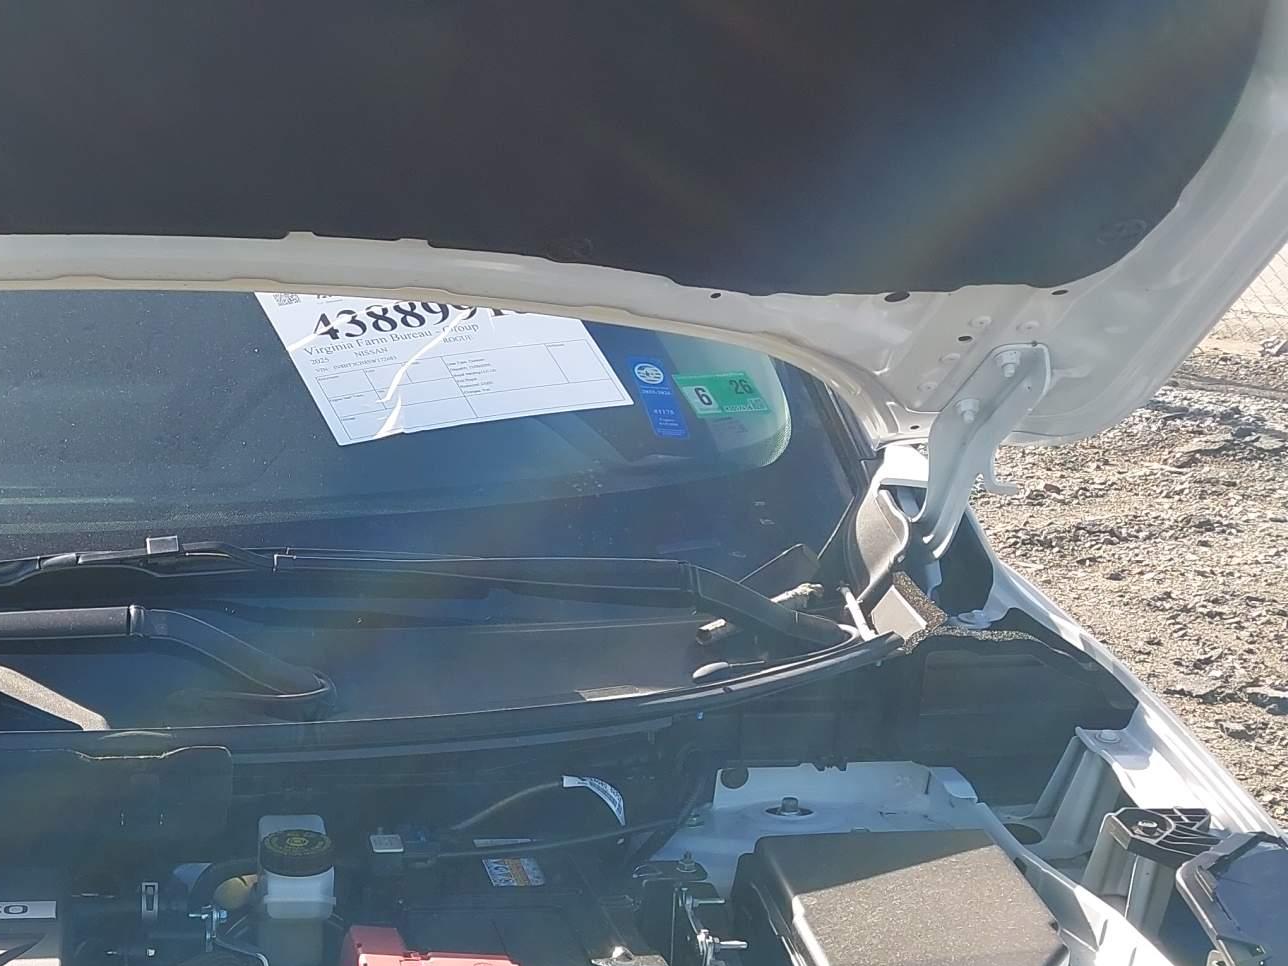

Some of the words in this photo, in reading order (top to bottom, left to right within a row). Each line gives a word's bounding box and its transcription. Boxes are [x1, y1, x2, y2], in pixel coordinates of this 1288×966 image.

[304, 341, 354, 357] Virginia
[355, 336, 389, 349] Farm
[390, 329, 432, 344] Bureau
[353, 347, 389, 358] NISSAN
[728, 379, 753, 395] 26
[694, 387, 713, 406] 6
